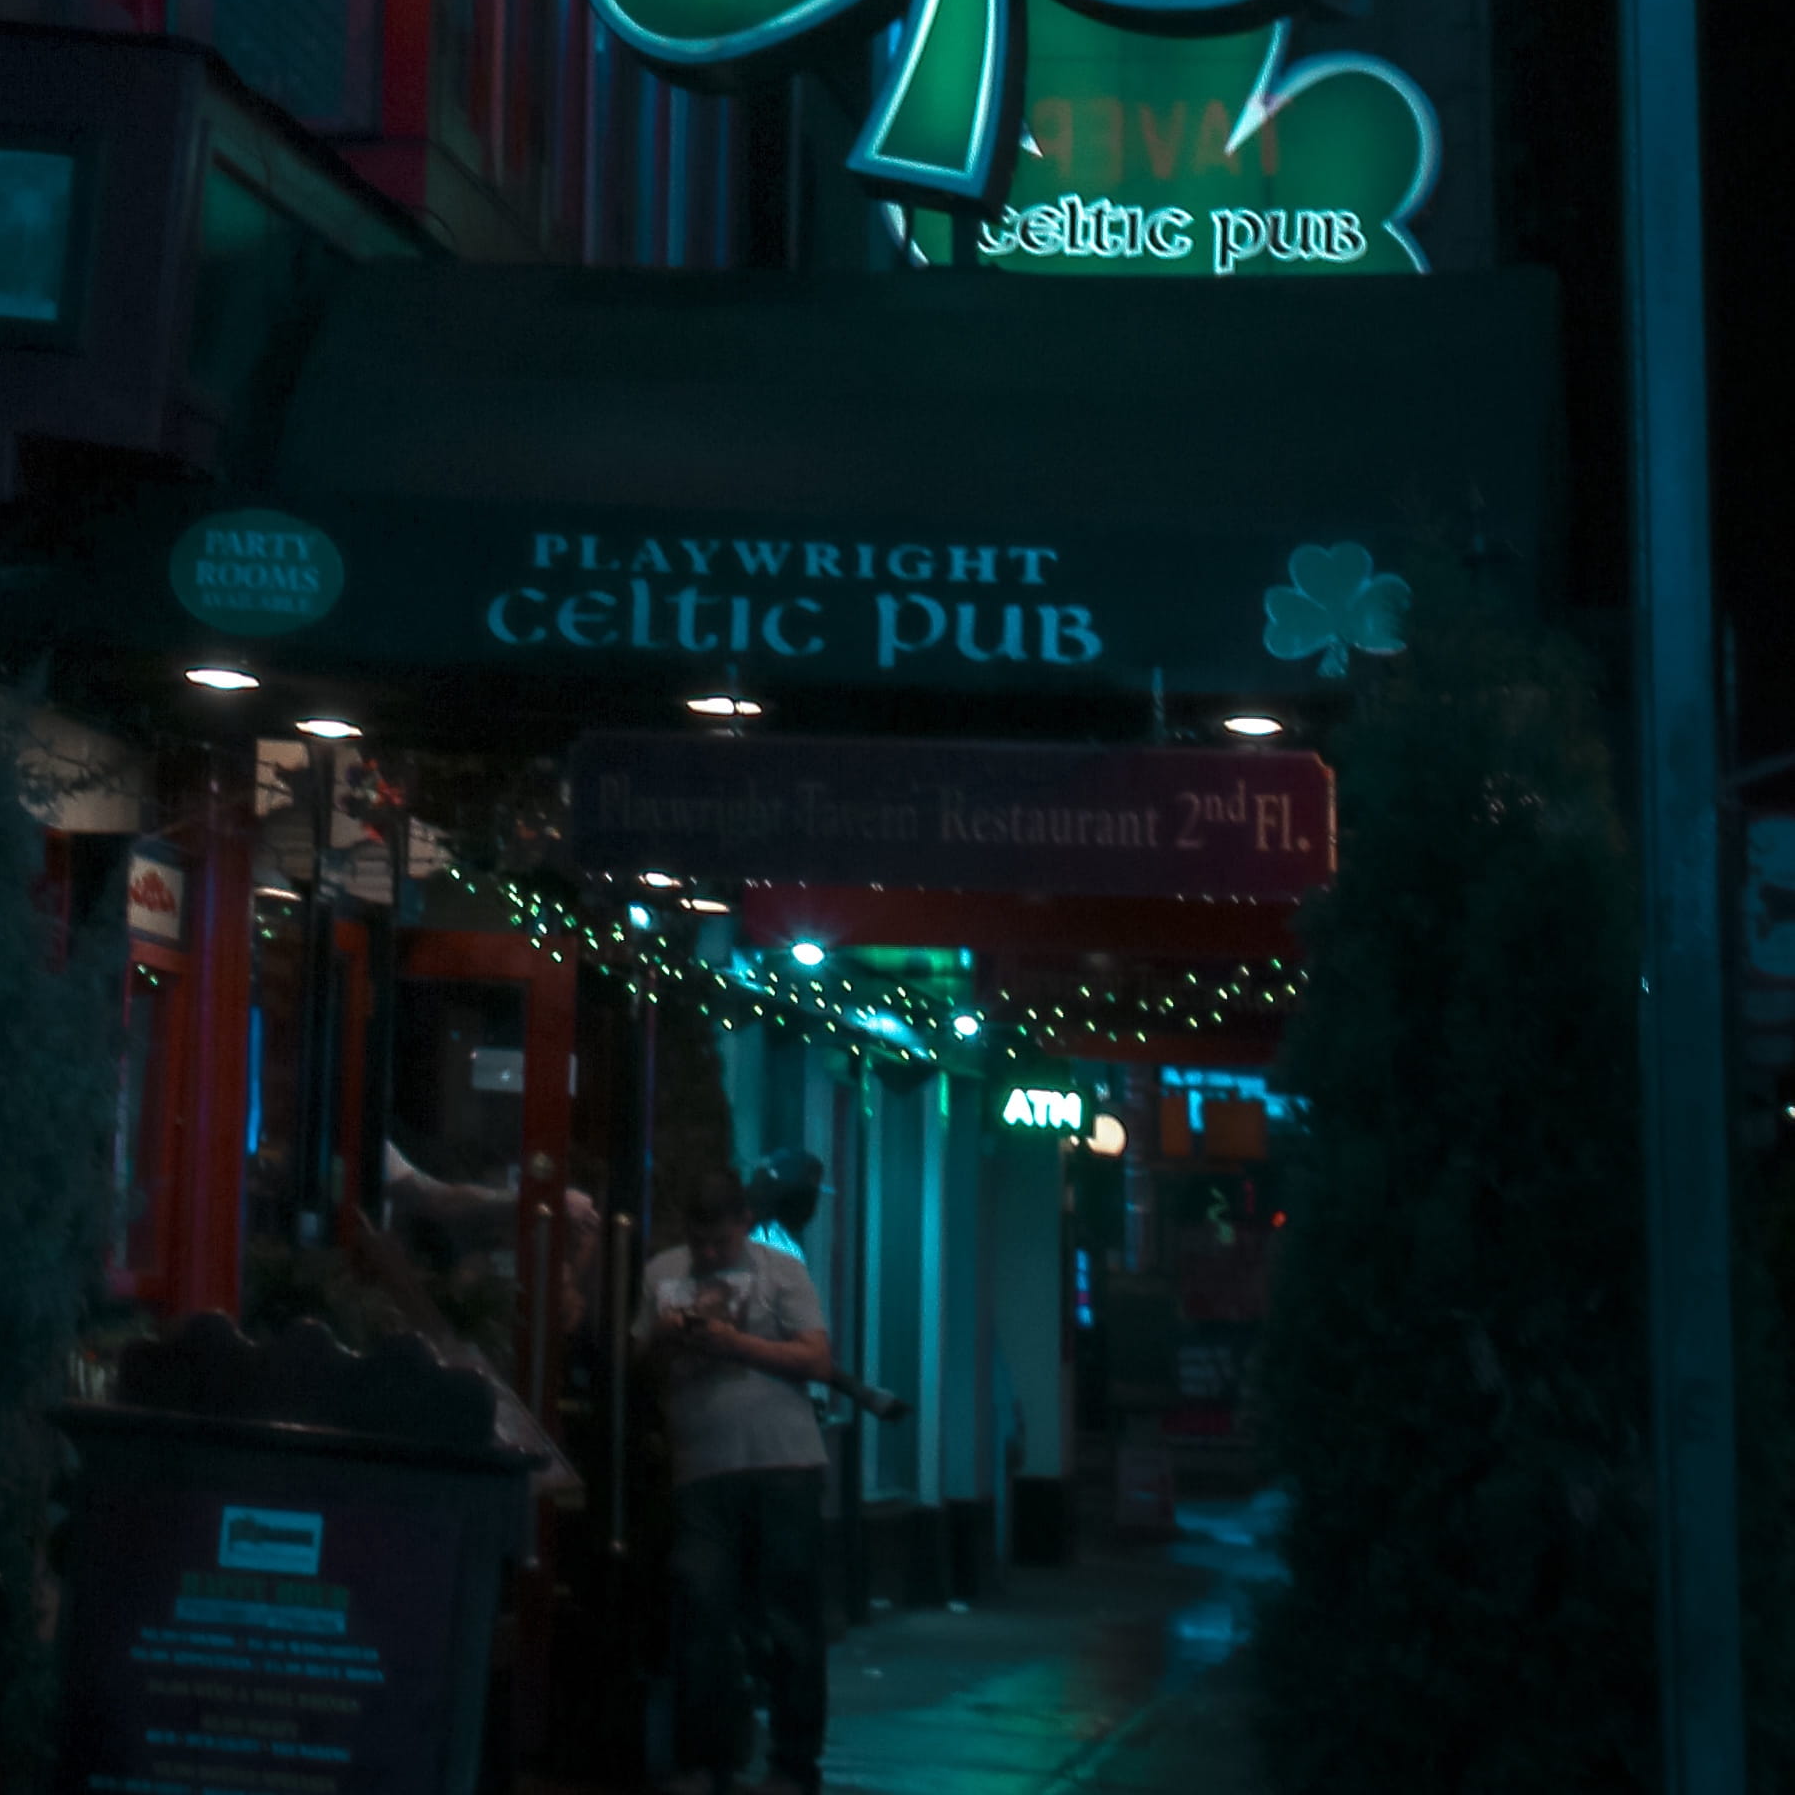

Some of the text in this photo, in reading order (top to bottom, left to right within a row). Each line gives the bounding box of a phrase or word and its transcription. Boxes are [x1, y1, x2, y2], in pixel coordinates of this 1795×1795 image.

[205, 529, 310, 561] PARTY
[532, 532, 1060, 586] PLAYWRIGHT
[194, 559, 322, 593] ROOMS
[939, 786, 1160, 849] Restaurant
[1175, 779, 1247, 850] 2nd
[1255, 792, 1313, 853] Fl.
[1002, 1086, 1084, 1131] ATM
